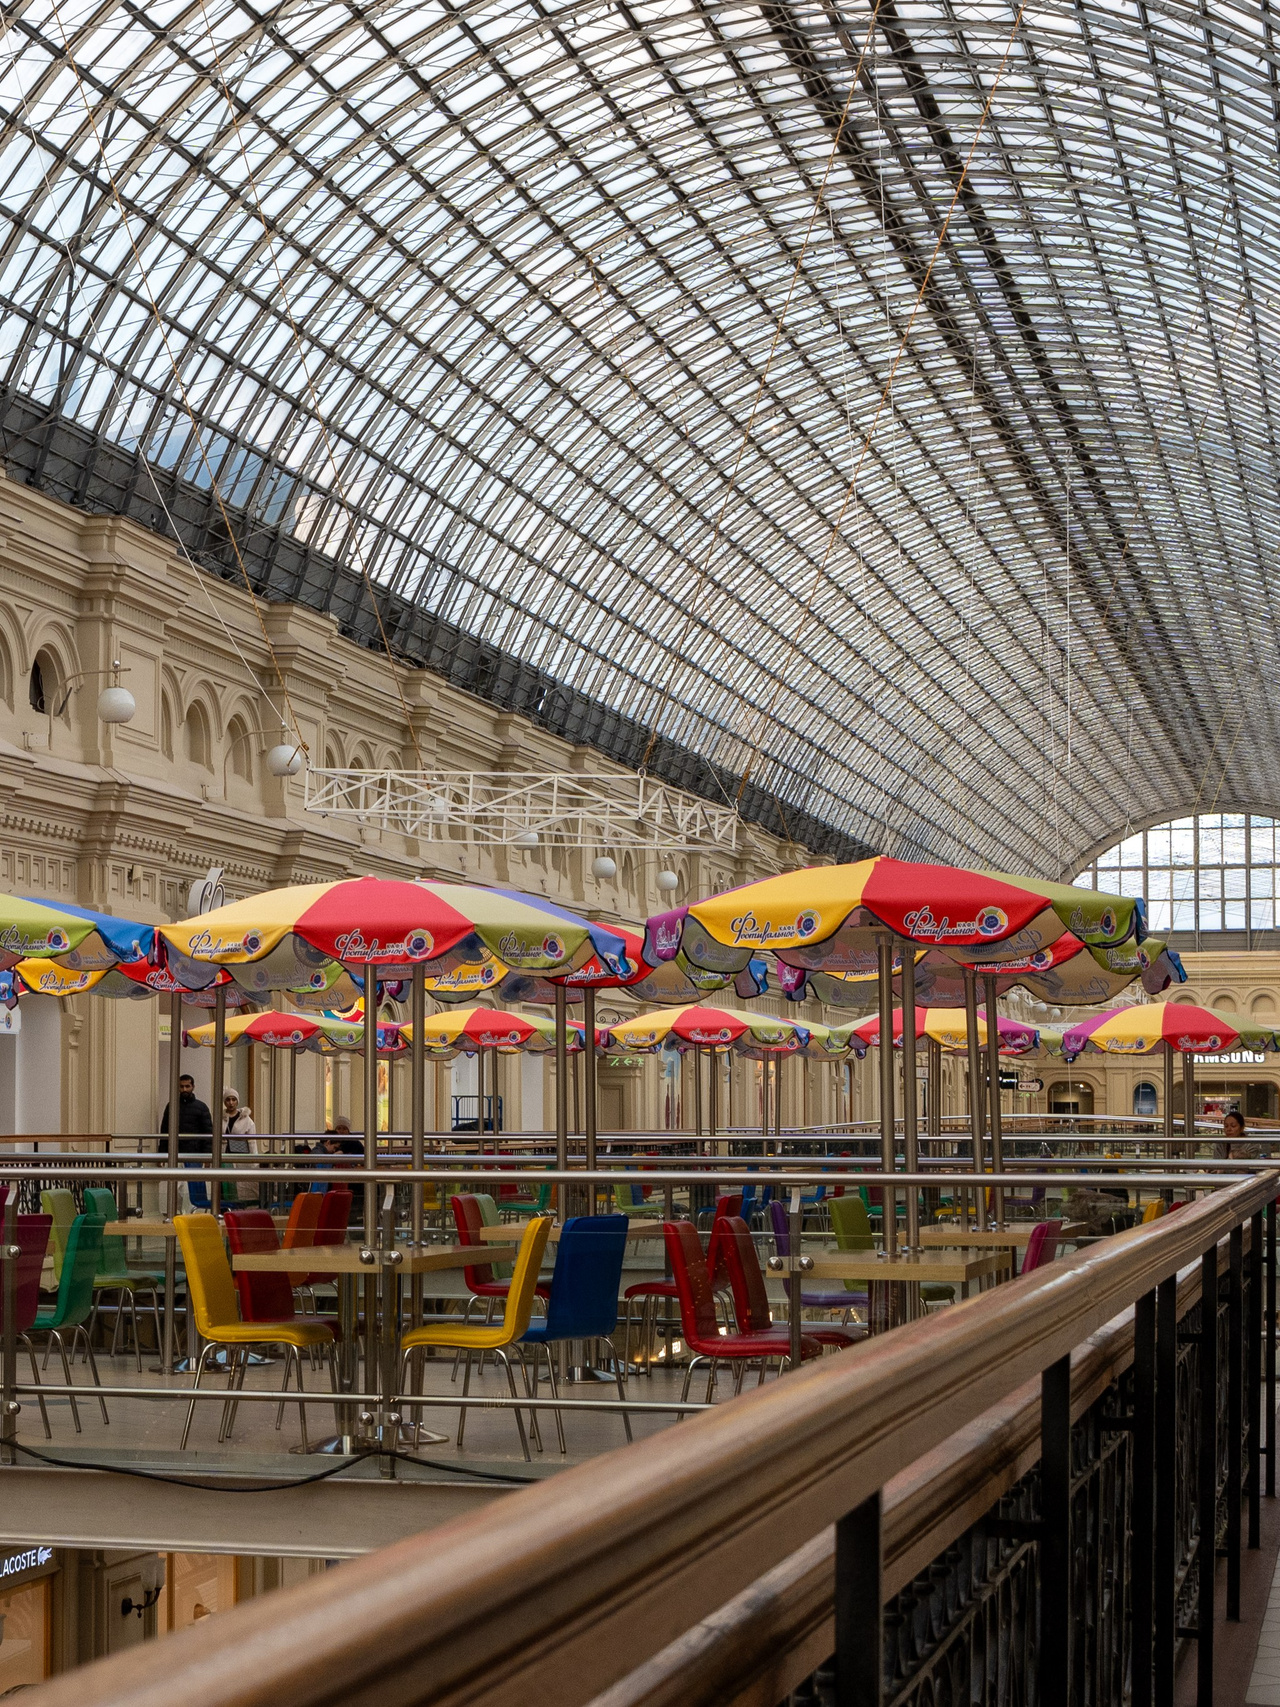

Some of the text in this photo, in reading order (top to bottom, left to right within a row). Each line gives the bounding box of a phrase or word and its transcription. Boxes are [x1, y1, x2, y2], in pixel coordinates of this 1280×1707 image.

[730, 911, 796, 944] Фестивальное
[903, 906, 977, 941] Фестивальное
[335, 929, 404, 961] Фестивальное
[1186, 1050, 1266, 1064] AMSUNG
